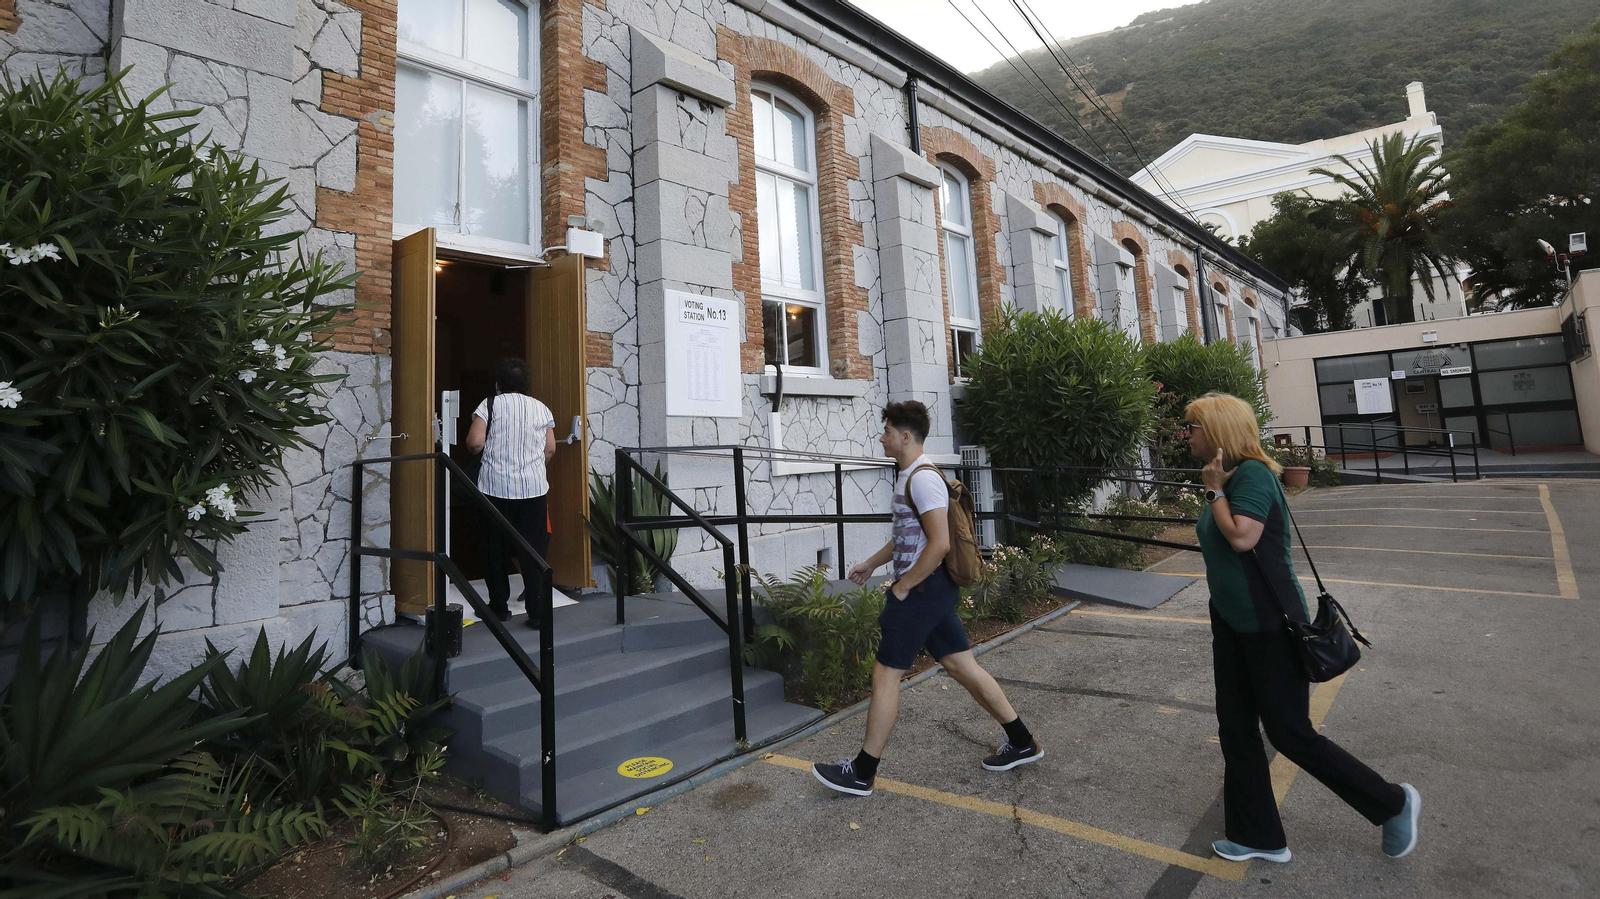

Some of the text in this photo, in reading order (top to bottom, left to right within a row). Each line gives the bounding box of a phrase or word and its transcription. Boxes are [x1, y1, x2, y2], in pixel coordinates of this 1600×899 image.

[684, 300, 704, 310] VOTING
[684, 311, 705, 321] STATION
[707, 307, 727, 321] No.13
[625, 759, 647, 768] PLEASE
[627, 759, 656, 772] MAINTAIN
[635, 763, 658, 772] SOCIAL
[634, 762, 670, 777] DISTANCING
